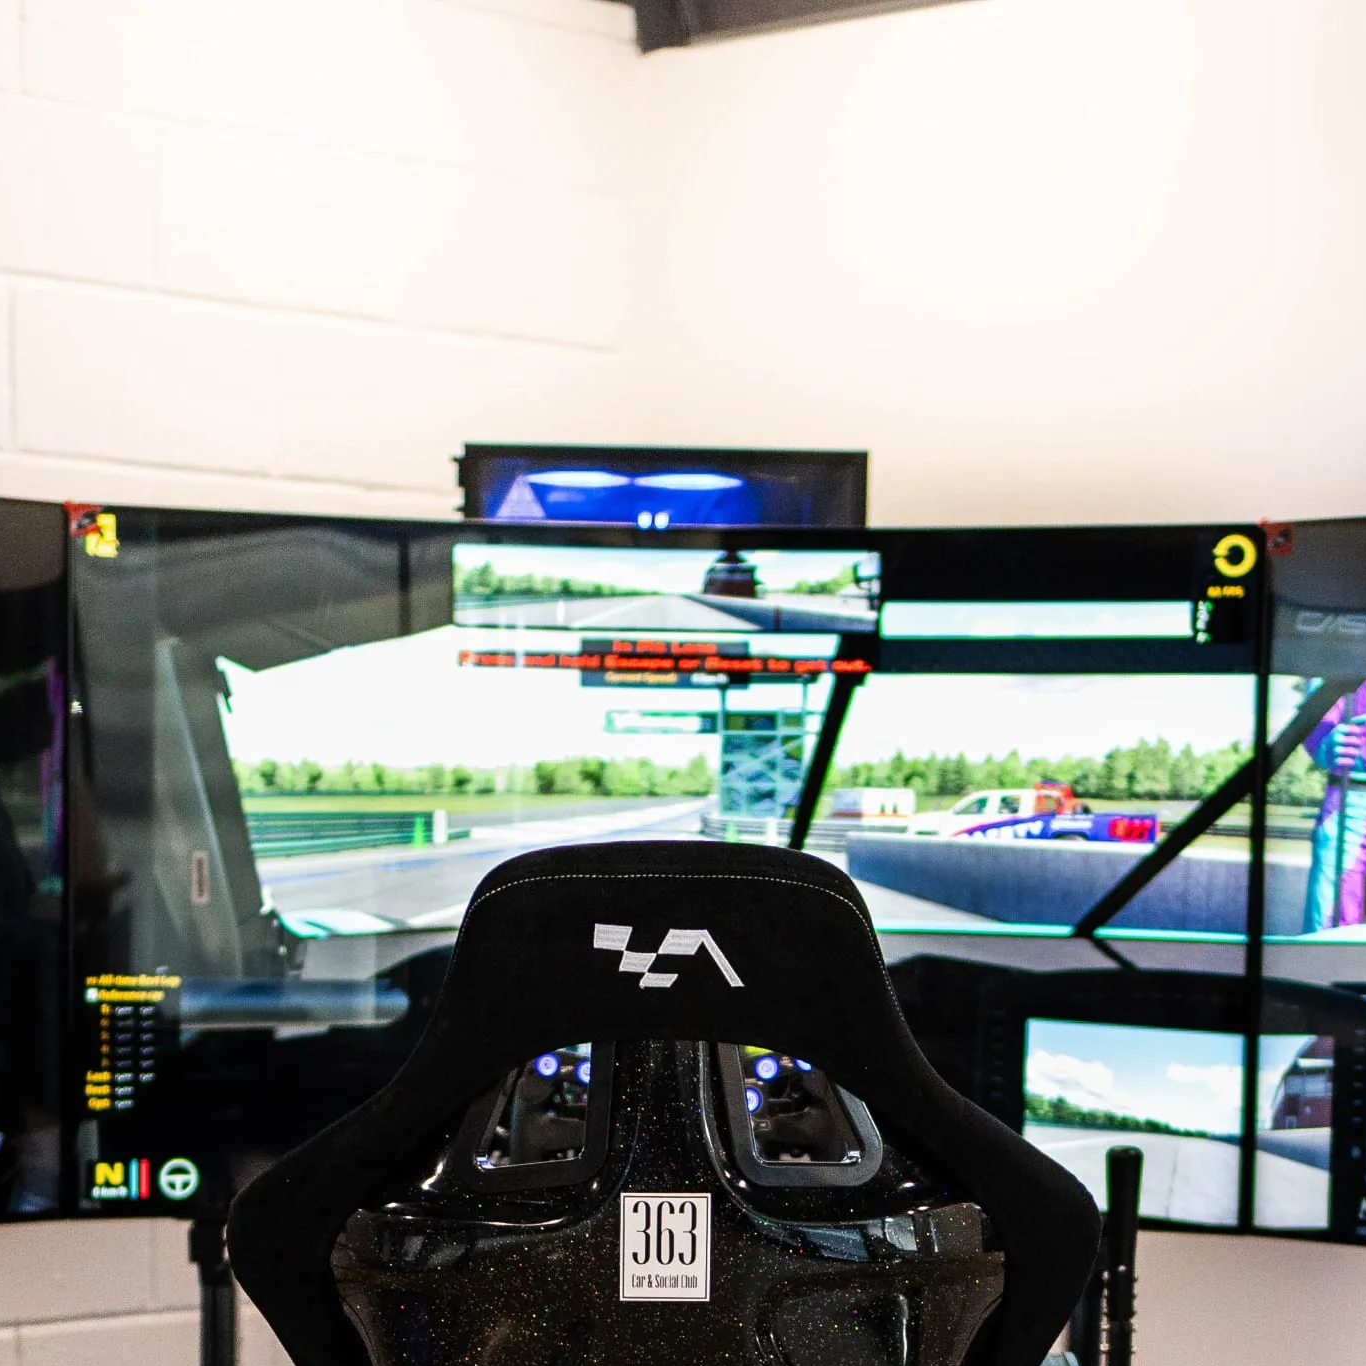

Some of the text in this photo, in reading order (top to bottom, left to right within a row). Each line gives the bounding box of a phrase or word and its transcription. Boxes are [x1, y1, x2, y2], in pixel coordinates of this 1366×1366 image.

[670, 641, 718, 655] Lane
[604, 654, 675, 671] Escape
[766, 658, 791, 671] to
[95, 1161, 125, 1186] N
[632, 1200, 698, 1266] 363
[631, 1273, 698, 1288] Car & Social Club
